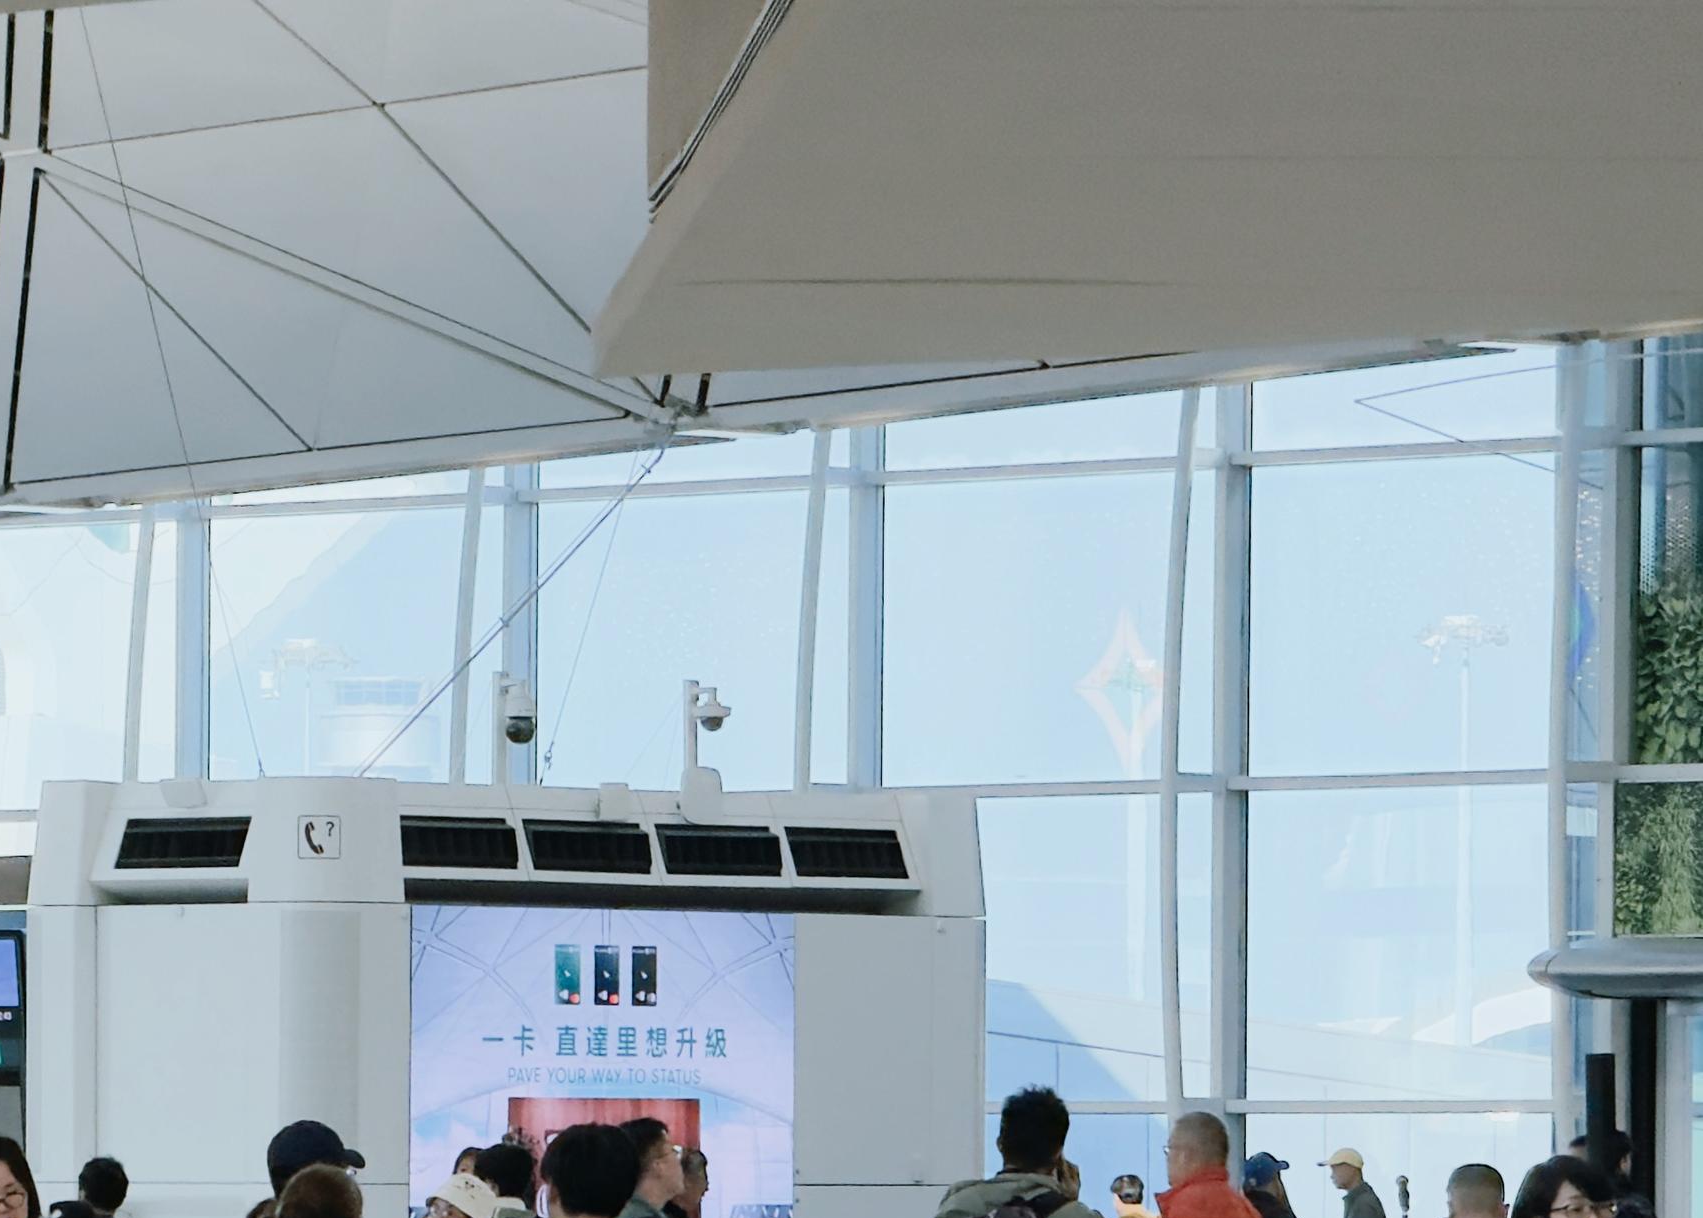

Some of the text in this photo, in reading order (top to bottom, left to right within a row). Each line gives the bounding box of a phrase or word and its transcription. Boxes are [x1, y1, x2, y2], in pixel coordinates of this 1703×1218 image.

[508, 1067, 702, 1084] PAVE YOUR WAY TO STATUS
